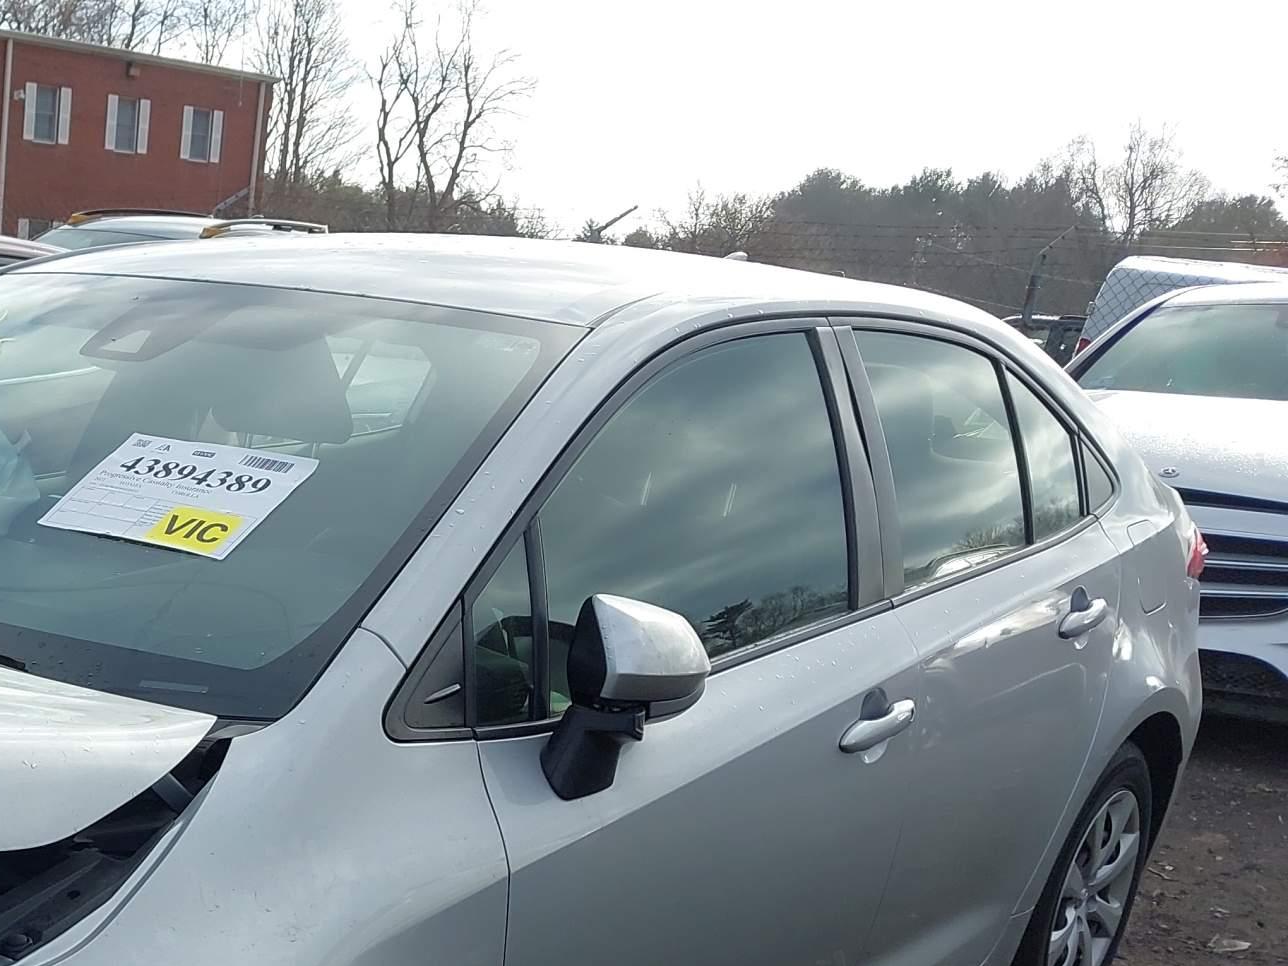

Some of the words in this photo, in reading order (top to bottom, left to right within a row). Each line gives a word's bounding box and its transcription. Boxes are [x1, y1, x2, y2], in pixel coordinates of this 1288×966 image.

[99, 469, 143, 482] Progressive
[142, 477, 174, 489] Casualty
[174, 484, 213, 495] Insurance
[119, 455, 272, 494] 43894389
[164, 514, 229, 543] VIC
